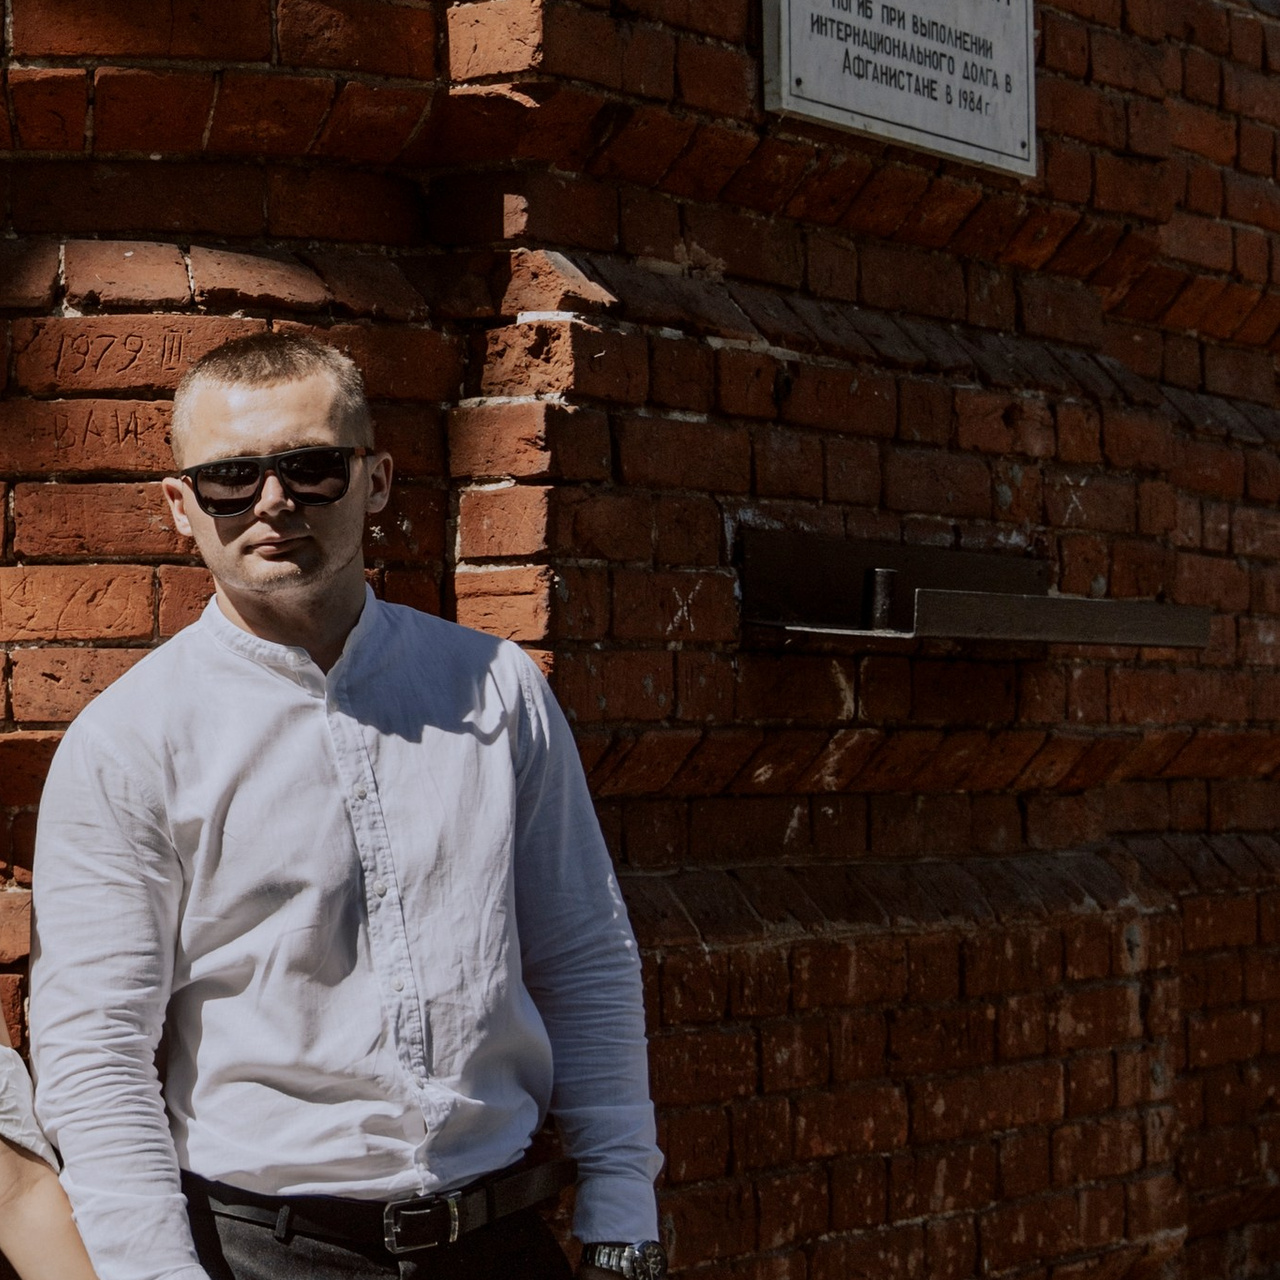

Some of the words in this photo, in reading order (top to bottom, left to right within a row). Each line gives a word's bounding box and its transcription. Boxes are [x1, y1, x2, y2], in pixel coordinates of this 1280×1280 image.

[810, 12, 956, 76] ИНТЕРНАЦИОНАЛЬНОГО
[962, 60, 999, 91] ДОЛГА
[1005, 73, 1013, 94] В
[881, 3, 906, 31] ПРИ
[912, 13, 994, 61] ВЫПОЛНЕНИИ
[842, 48, 939, 102] АФГАНИСТАНЕ
[945, 84, 953, 105] В
